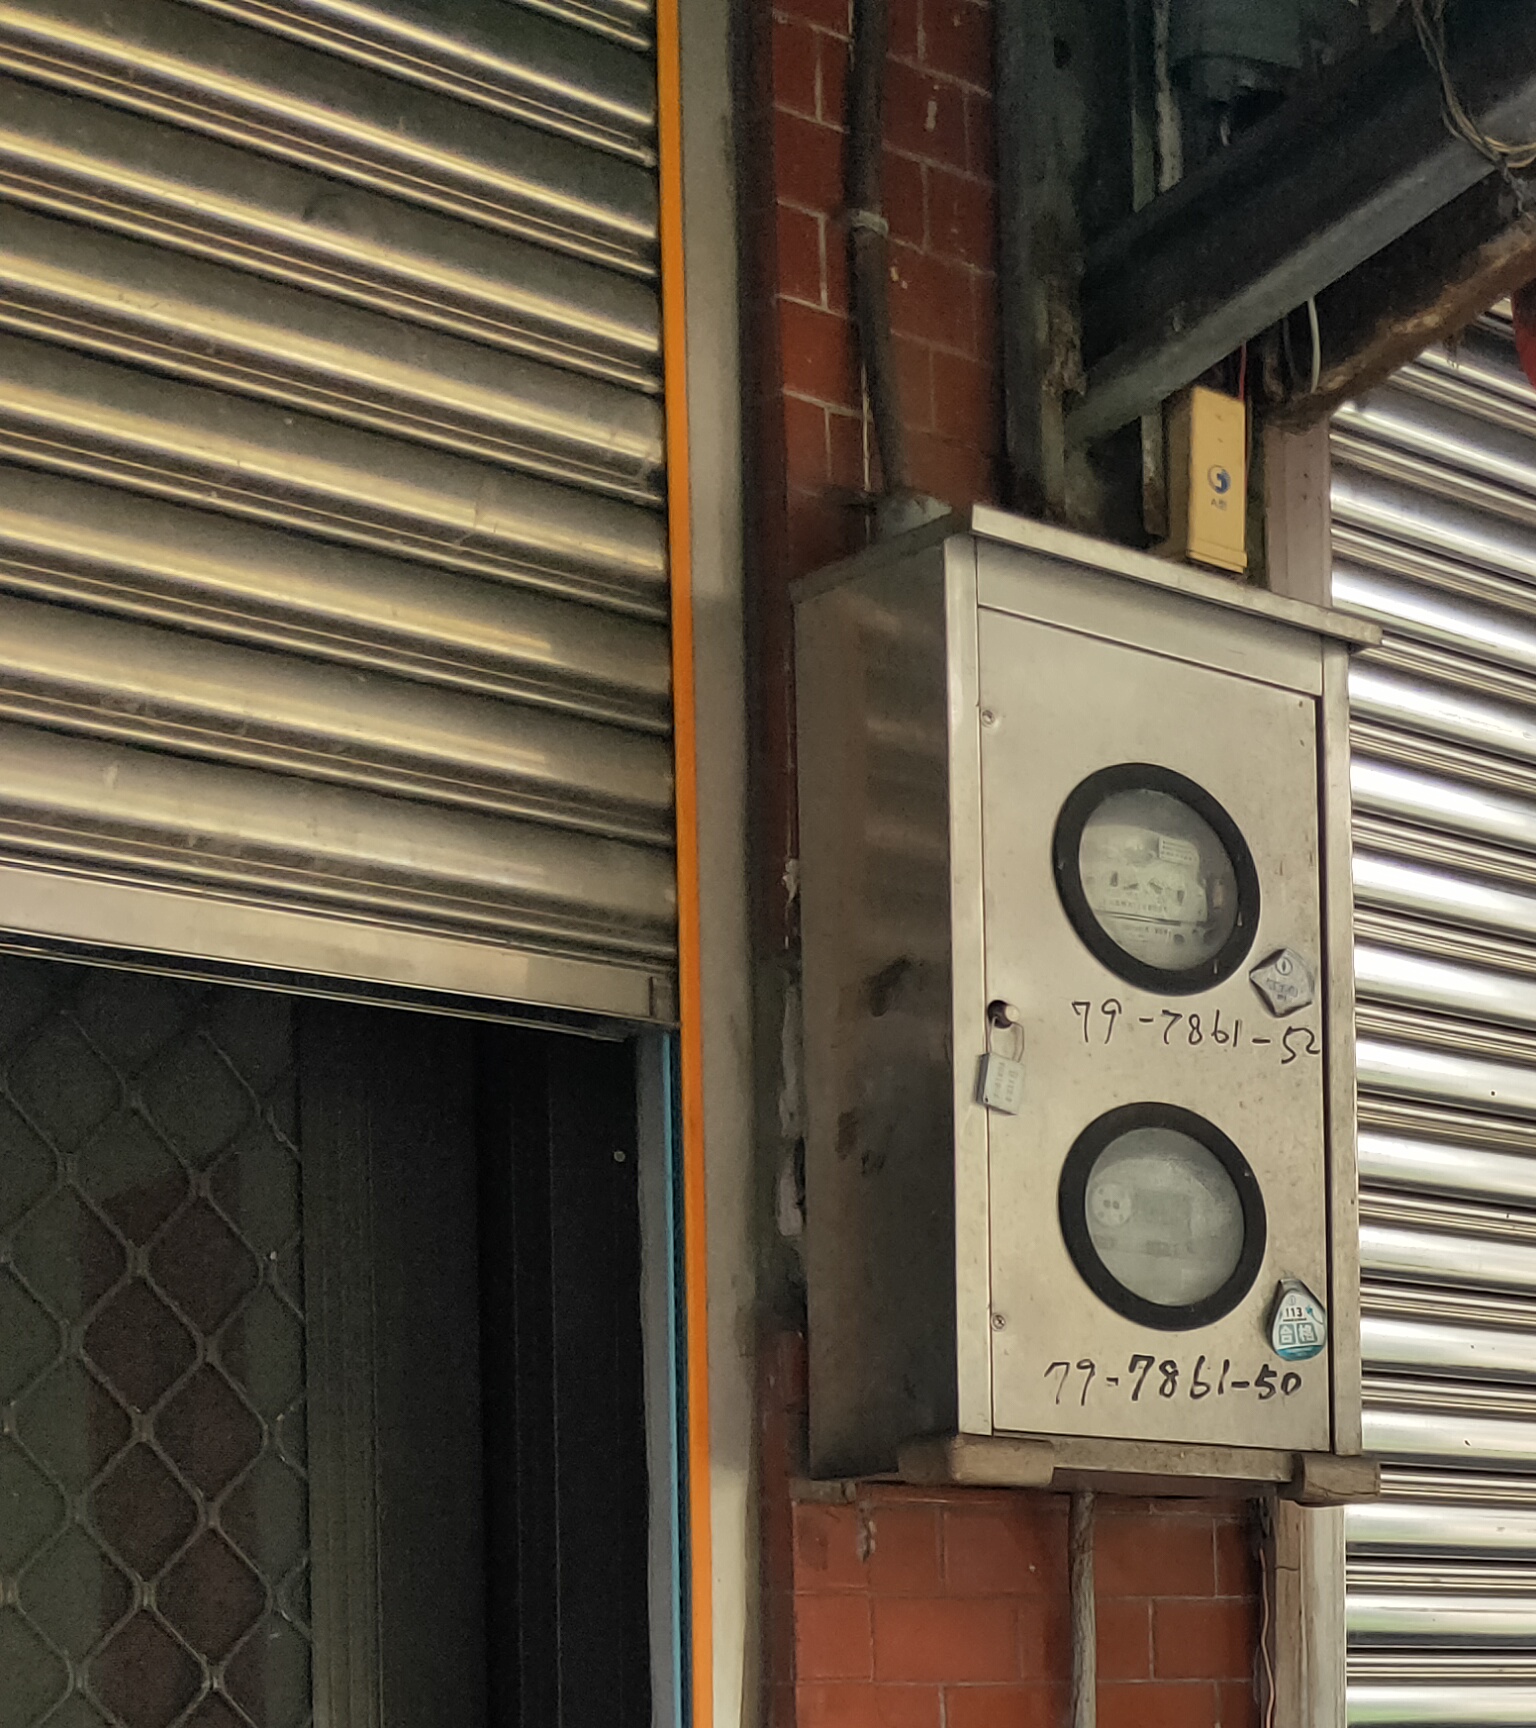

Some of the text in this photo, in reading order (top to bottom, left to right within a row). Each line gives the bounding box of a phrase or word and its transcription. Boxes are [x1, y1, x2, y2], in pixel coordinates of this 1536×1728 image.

[1071, 998, 1321, 1064] 79-7861-52
[1285, 1306, 1303, 1318] 113
[1044, 1354, 1303, 1406] 79-7861-50
